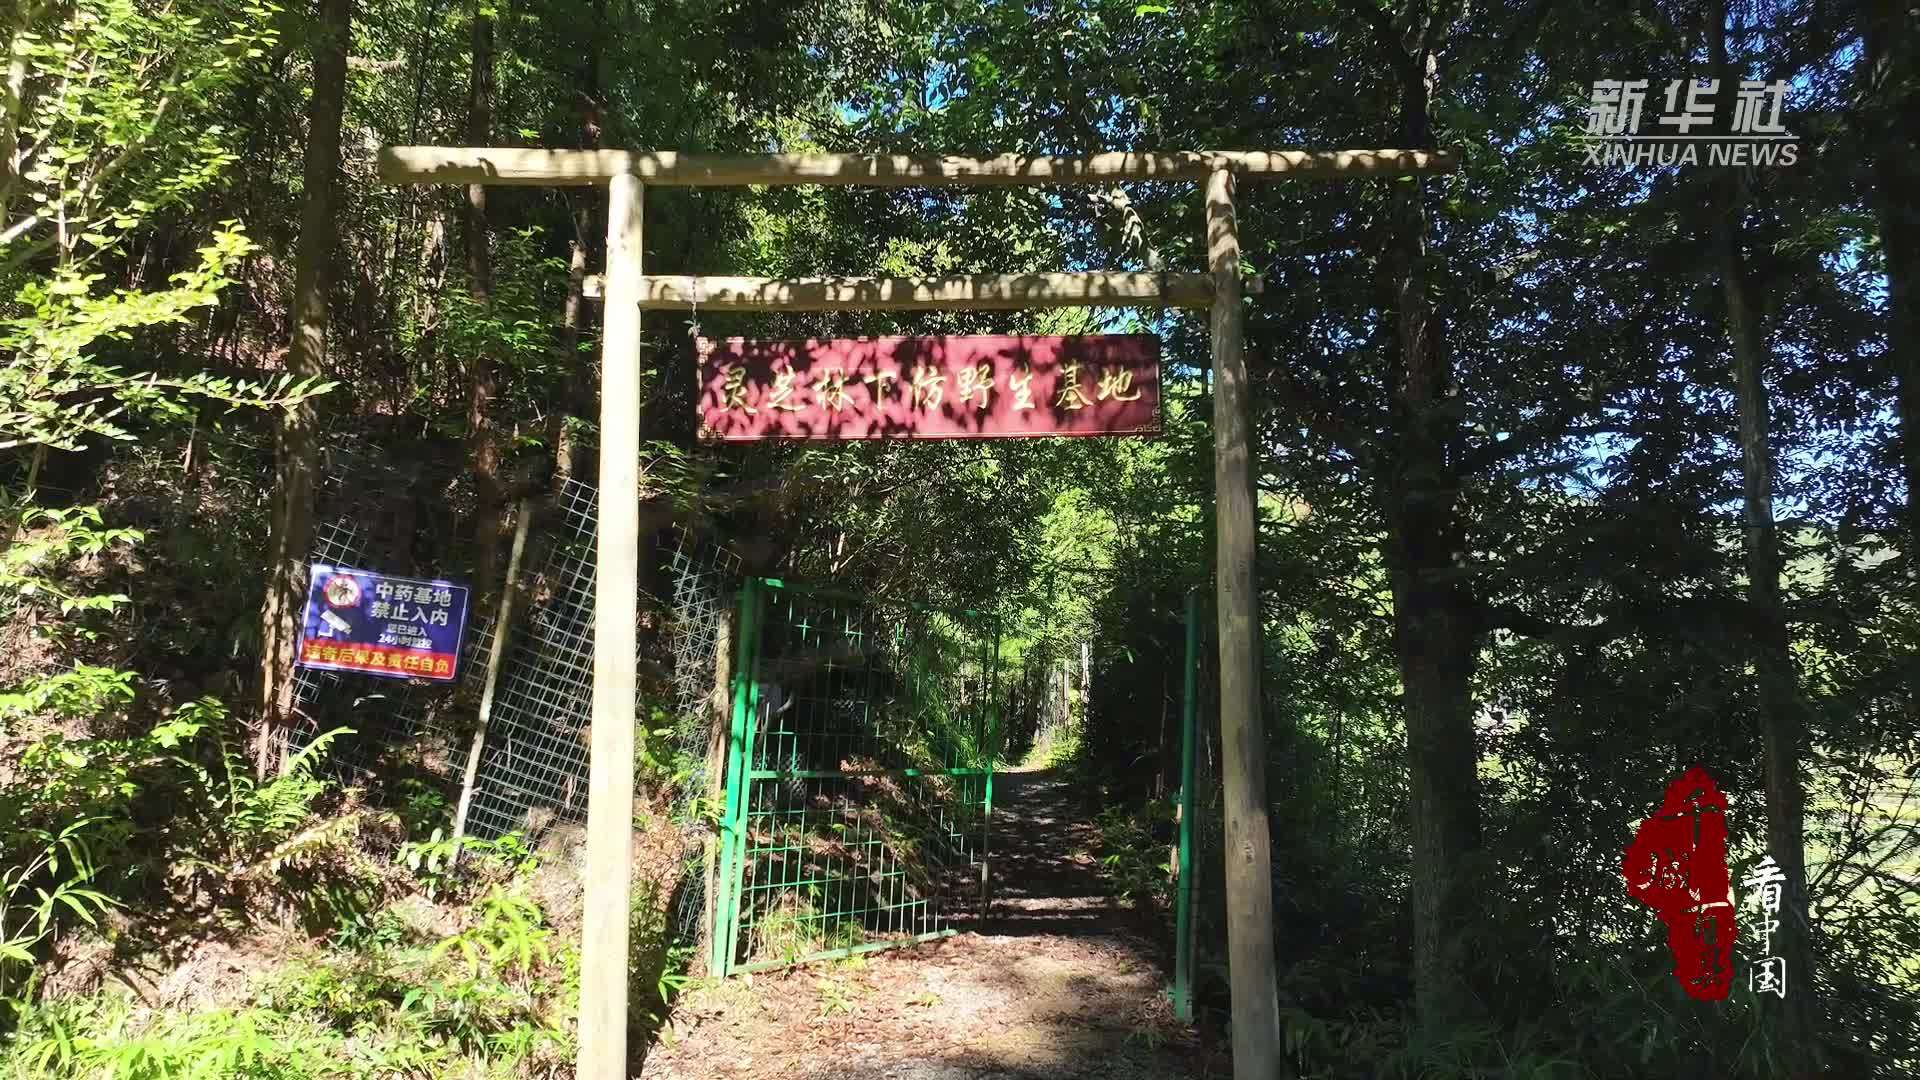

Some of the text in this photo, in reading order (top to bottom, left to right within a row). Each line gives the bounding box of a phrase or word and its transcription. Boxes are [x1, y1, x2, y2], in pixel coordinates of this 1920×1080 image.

[375, 581, 452, 607] 中药基地
[370, 600, 449, 626] 禁止入内
